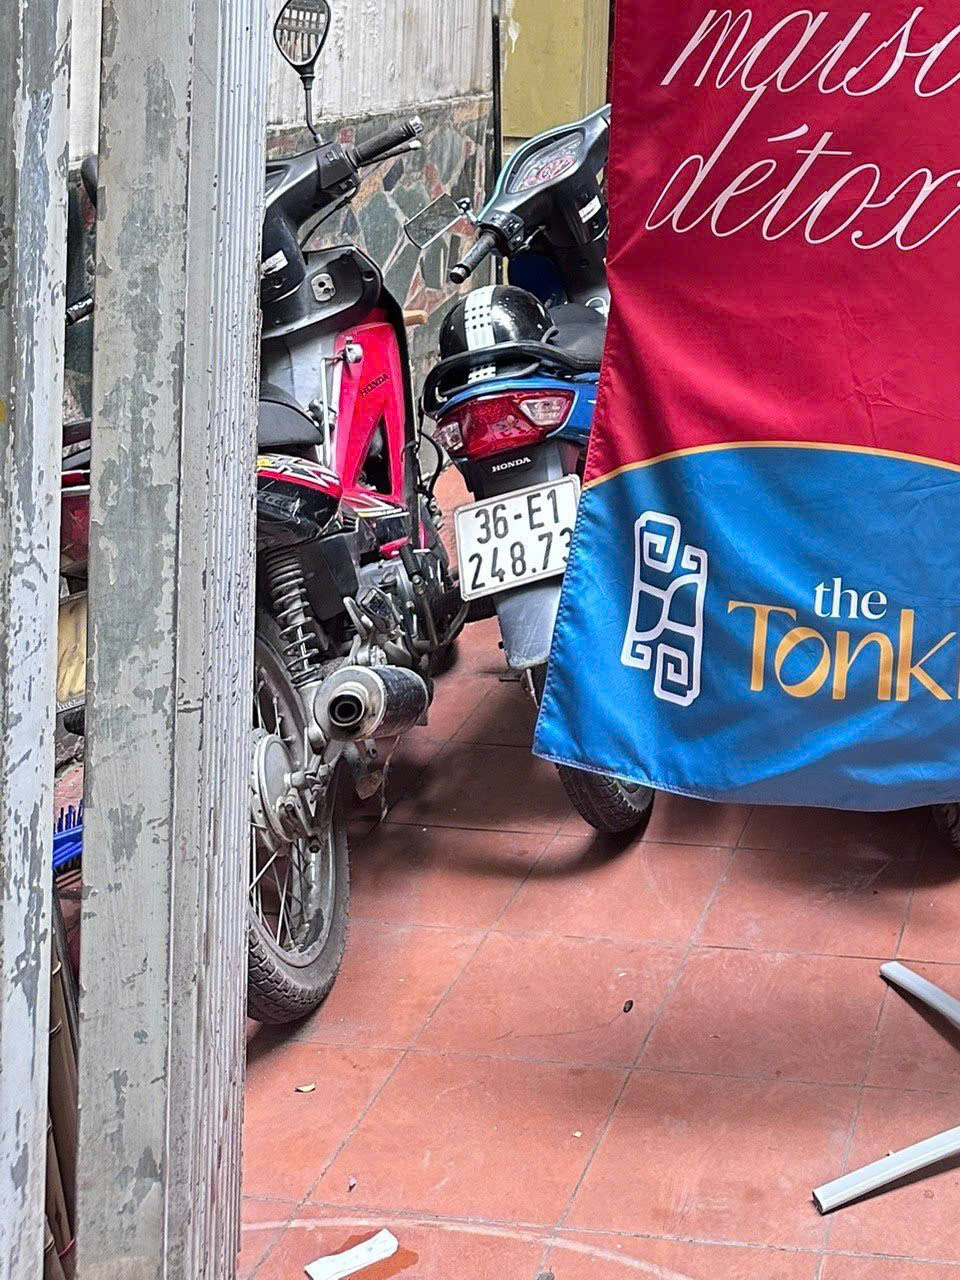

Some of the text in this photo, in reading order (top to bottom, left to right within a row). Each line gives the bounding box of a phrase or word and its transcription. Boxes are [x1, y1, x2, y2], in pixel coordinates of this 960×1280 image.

[361, 373, 389, 397] HONDA
[491, 456, 532, 473] HONDA
[474, 488, 560, 545] 36-E1
[813, 577, 888, 619] the
